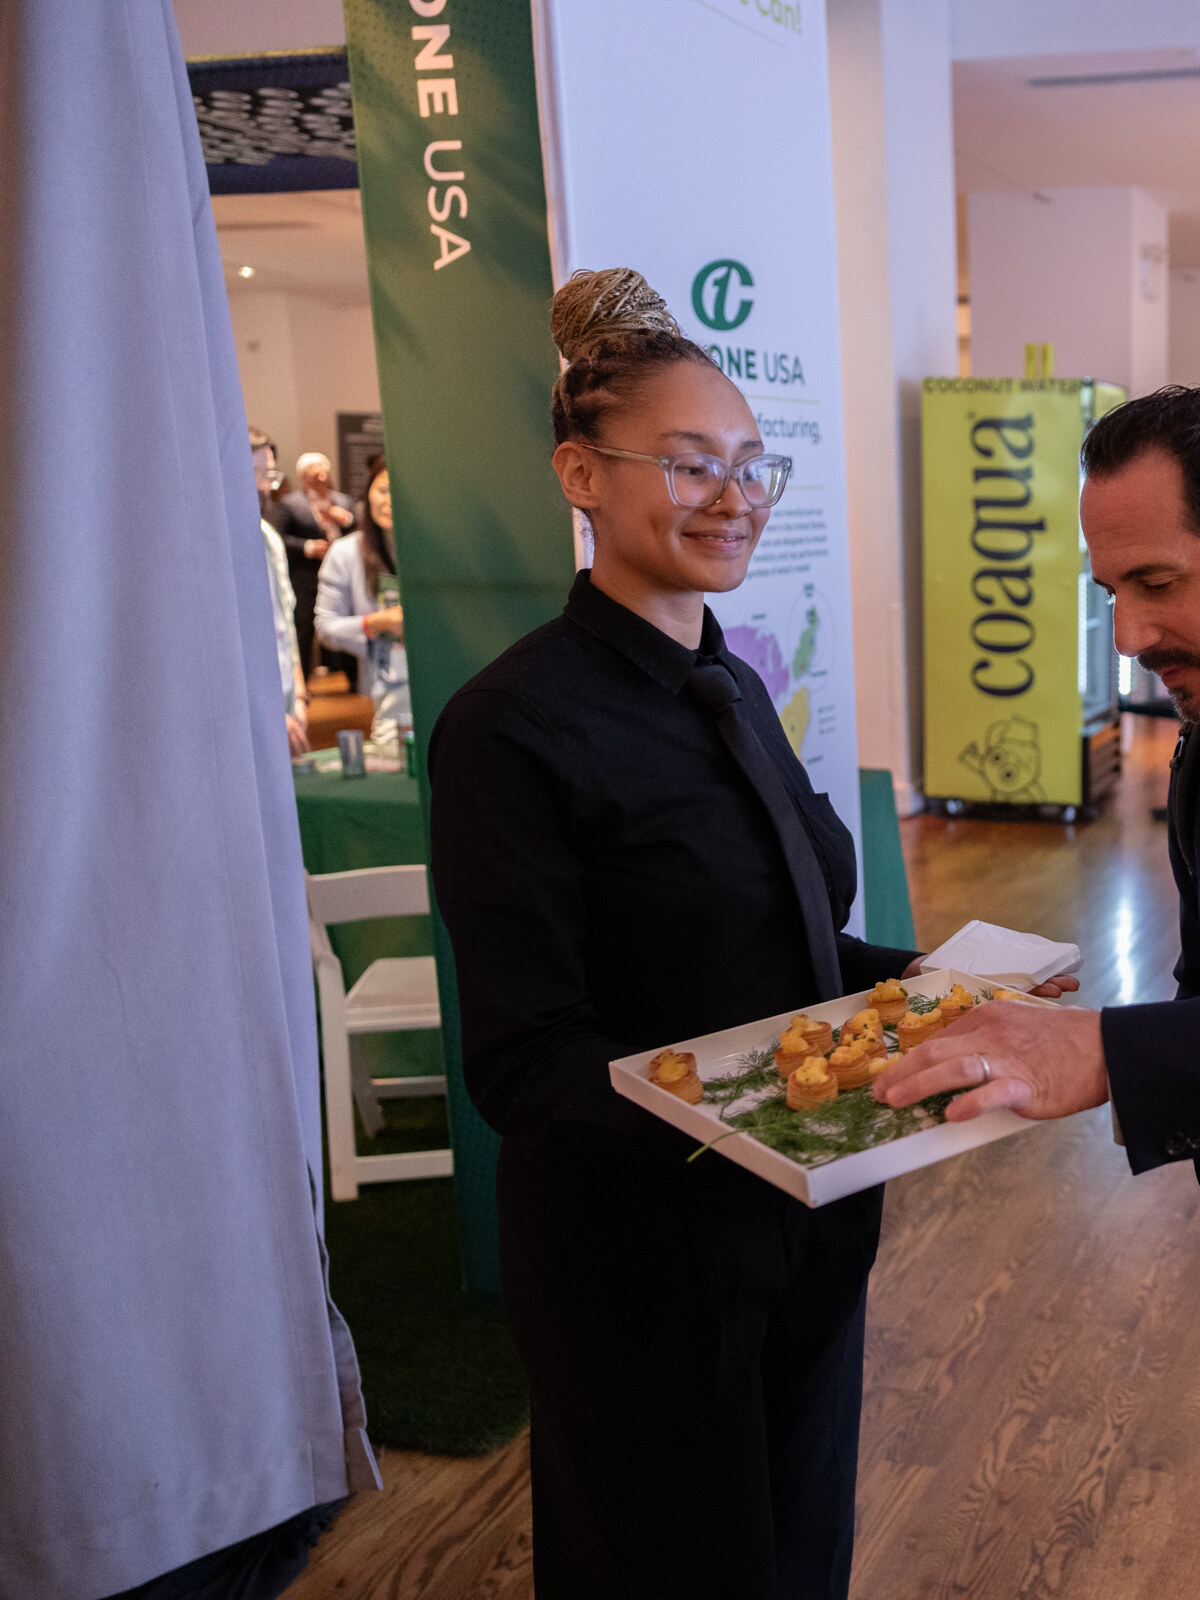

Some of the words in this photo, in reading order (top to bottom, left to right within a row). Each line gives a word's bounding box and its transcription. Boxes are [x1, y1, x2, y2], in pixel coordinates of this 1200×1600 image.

[423, 140, 472, 271] USA
[763, 350, 806, 385] USA
[922, 377, 1013, 395] COCONUT
[971, 412, 1046, 698] coaqua
